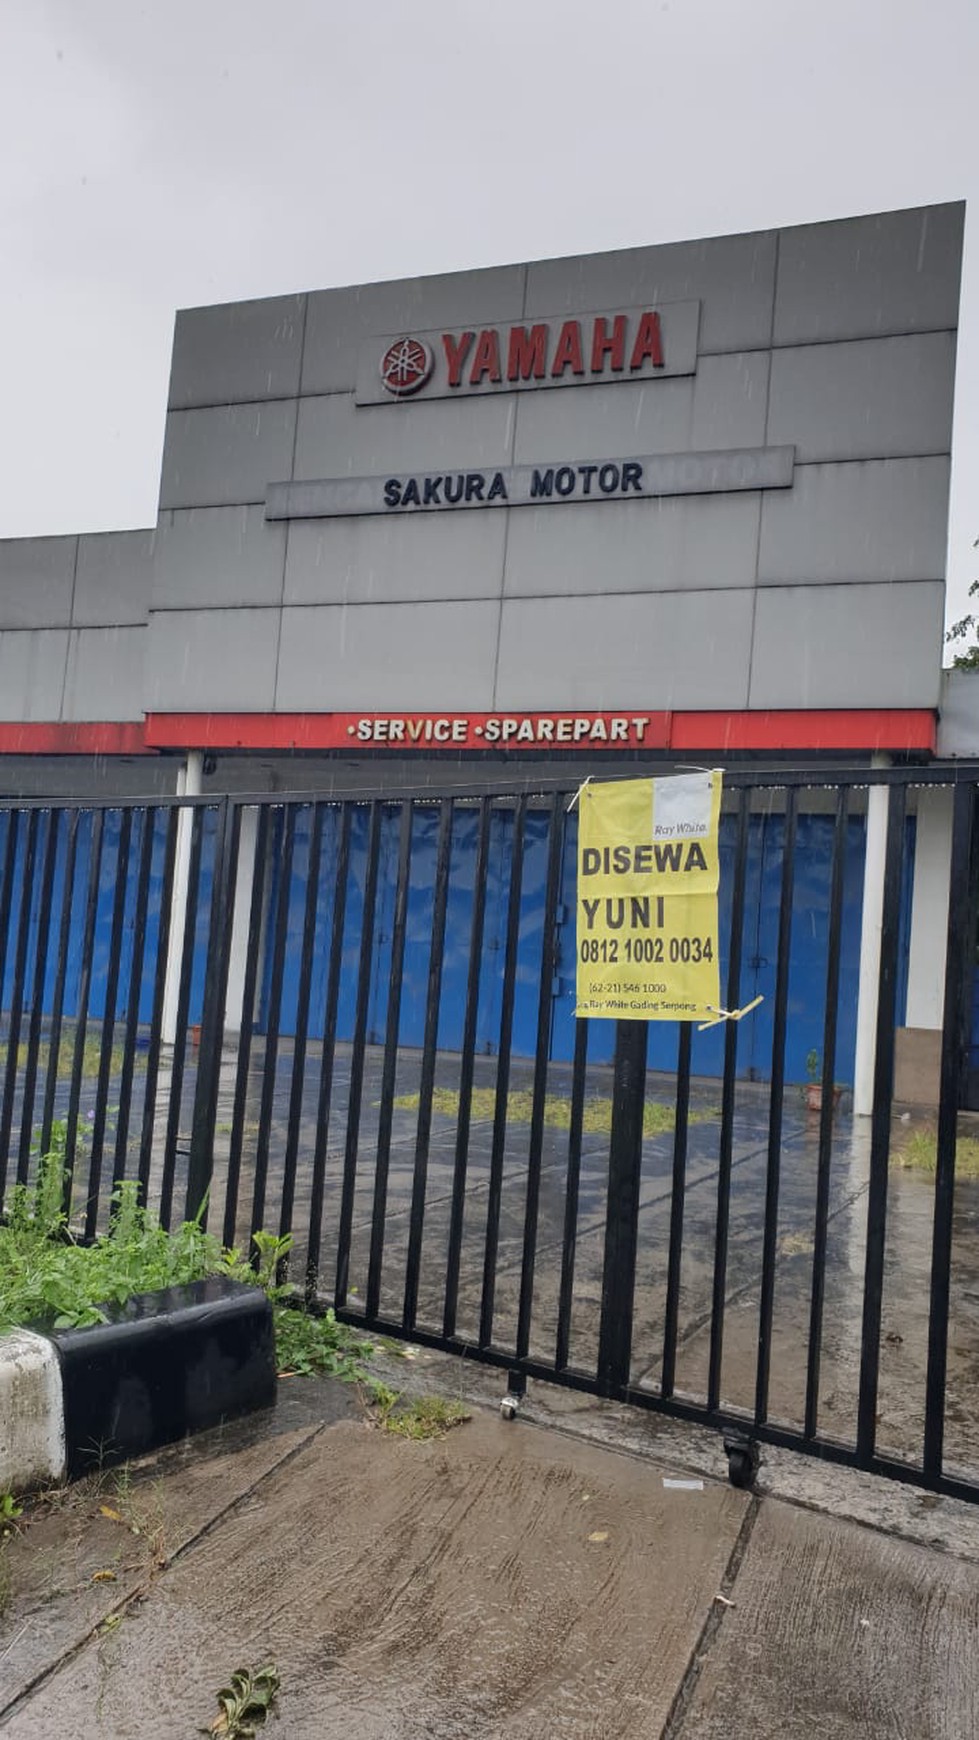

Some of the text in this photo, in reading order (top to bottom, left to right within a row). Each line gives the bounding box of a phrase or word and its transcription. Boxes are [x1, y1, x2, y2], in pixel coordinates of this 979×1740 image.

[442, 311, 665, 387] YAMAHA
[384, 472, 507, 508] SAKURA
[530, 461, 643, 499] MOTOR
[655, 825, 675, 836] Ray
[582, 842, 708, 876] DISEWA
[582, 896, 665, 930] YUNI
[581, 937, 713, 963] 0812 1002 0034
[623, 983, 640, 993] 546
[643, 983, 667, 993] 1000
[604, 1000, 628, 1009] White
[630, 1001, 659, 1011] Gading
[661, 1001, 696, 1012] Serpong
